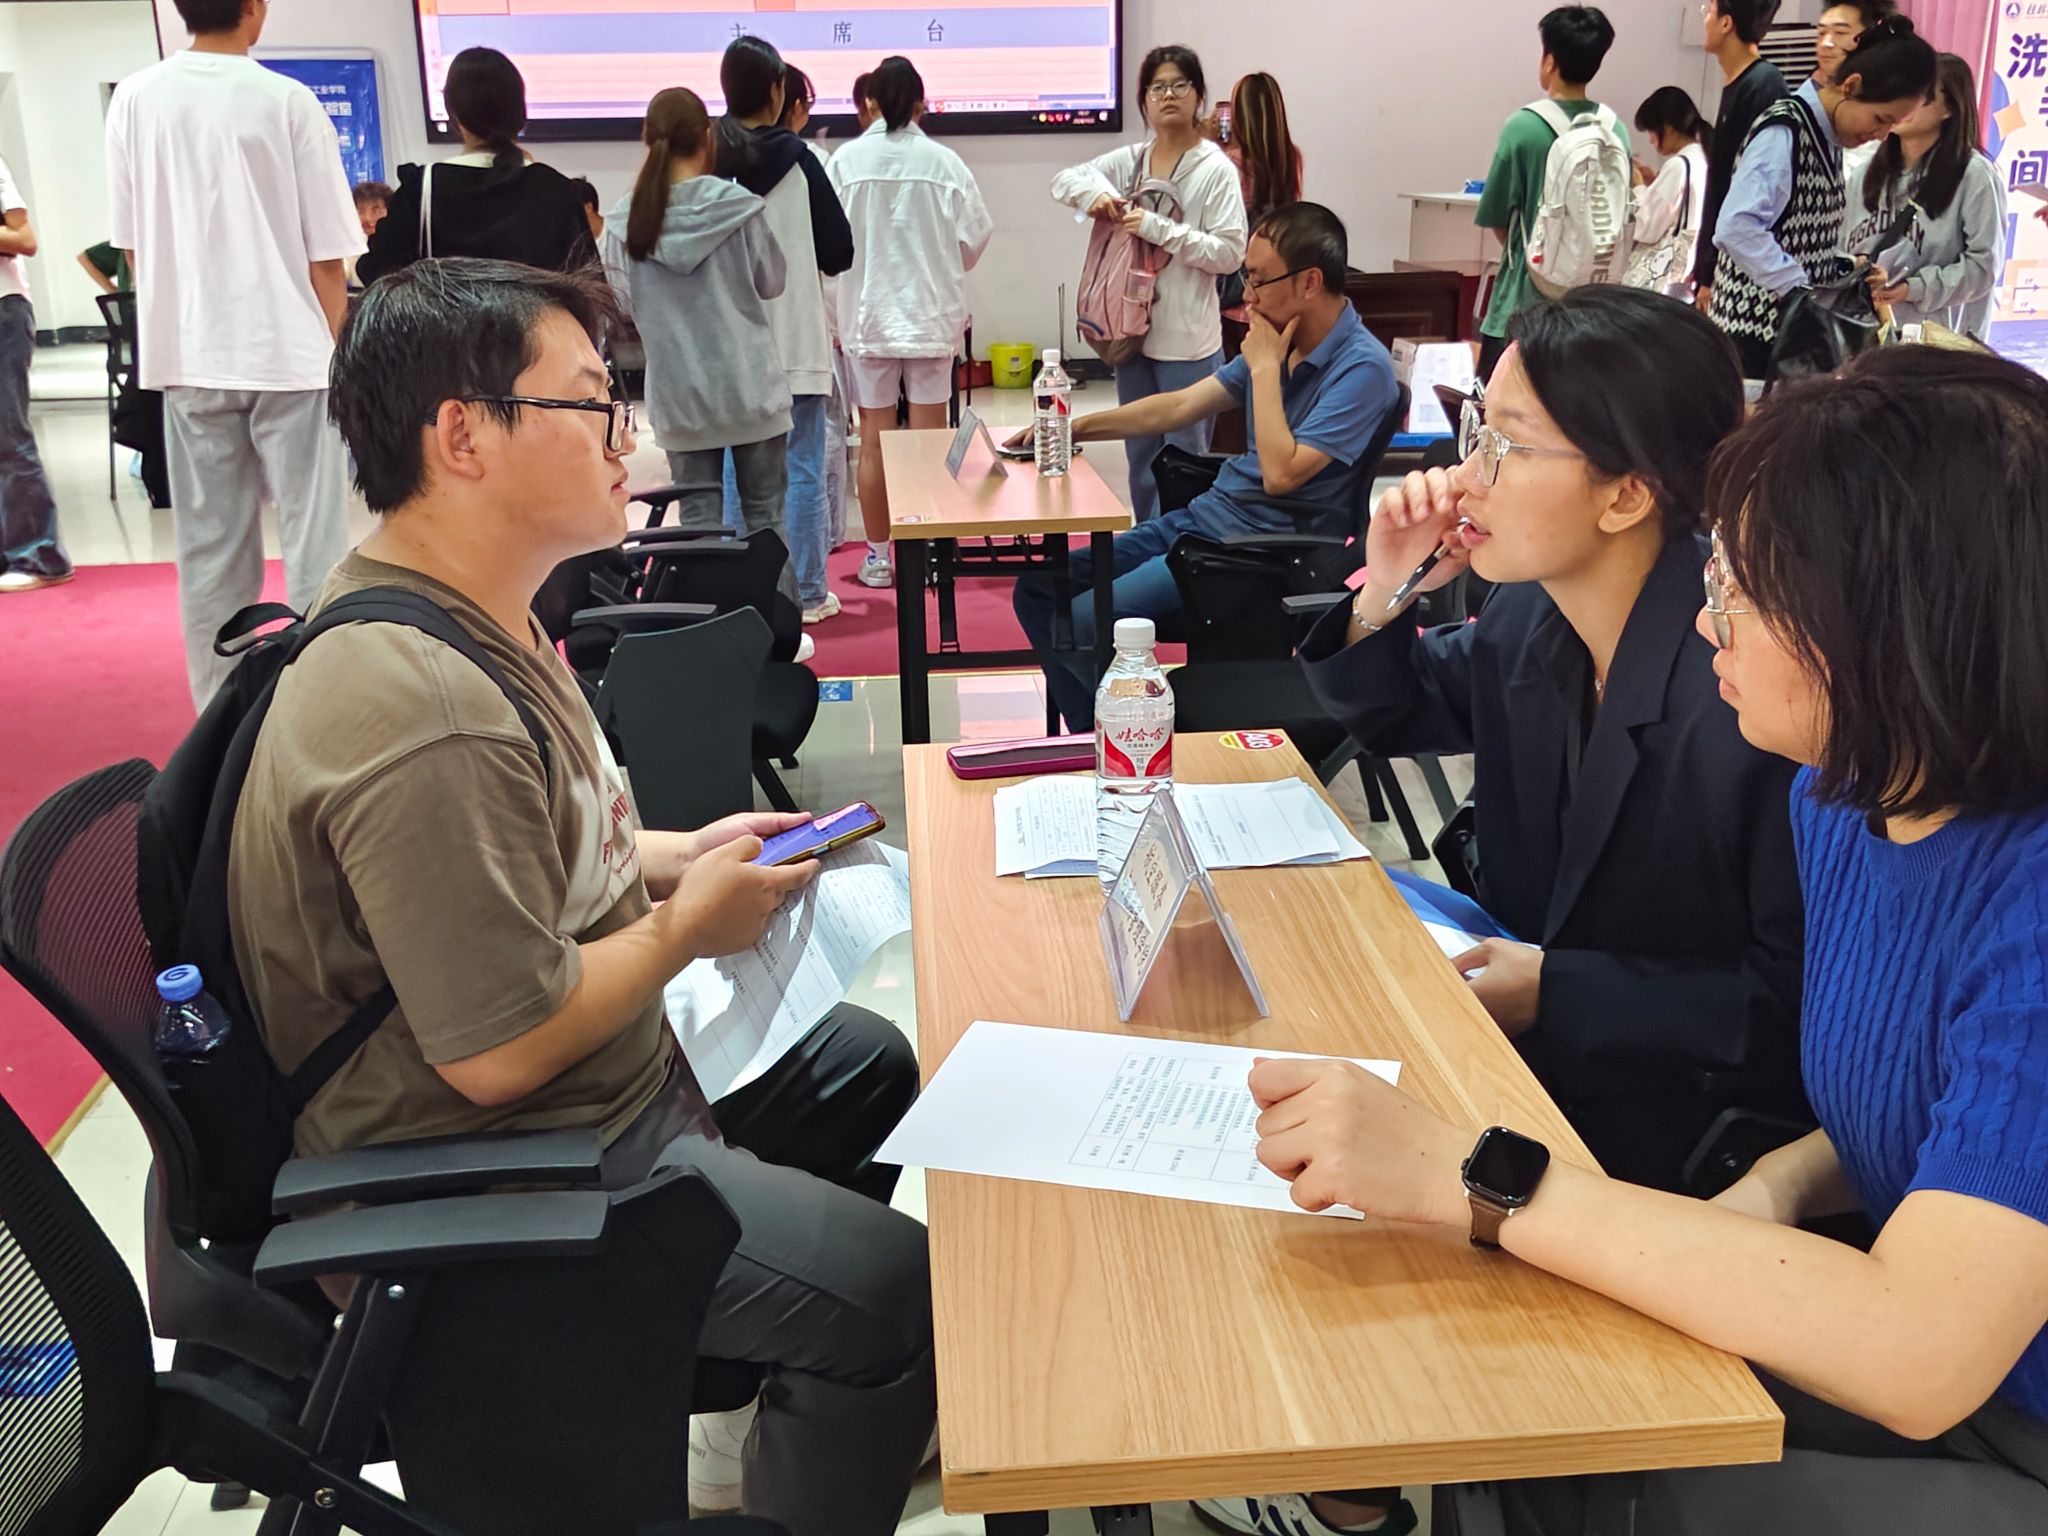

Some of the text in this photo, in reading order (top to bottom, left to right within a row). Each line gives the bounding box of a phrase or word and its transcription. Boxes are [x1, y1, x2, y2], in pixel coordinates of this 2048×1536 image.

[310, 85, 346, 95] 工业学院
[322, 102, 352, 116] 验室
[1115, 727, 1164, 742] 娃哈哈
